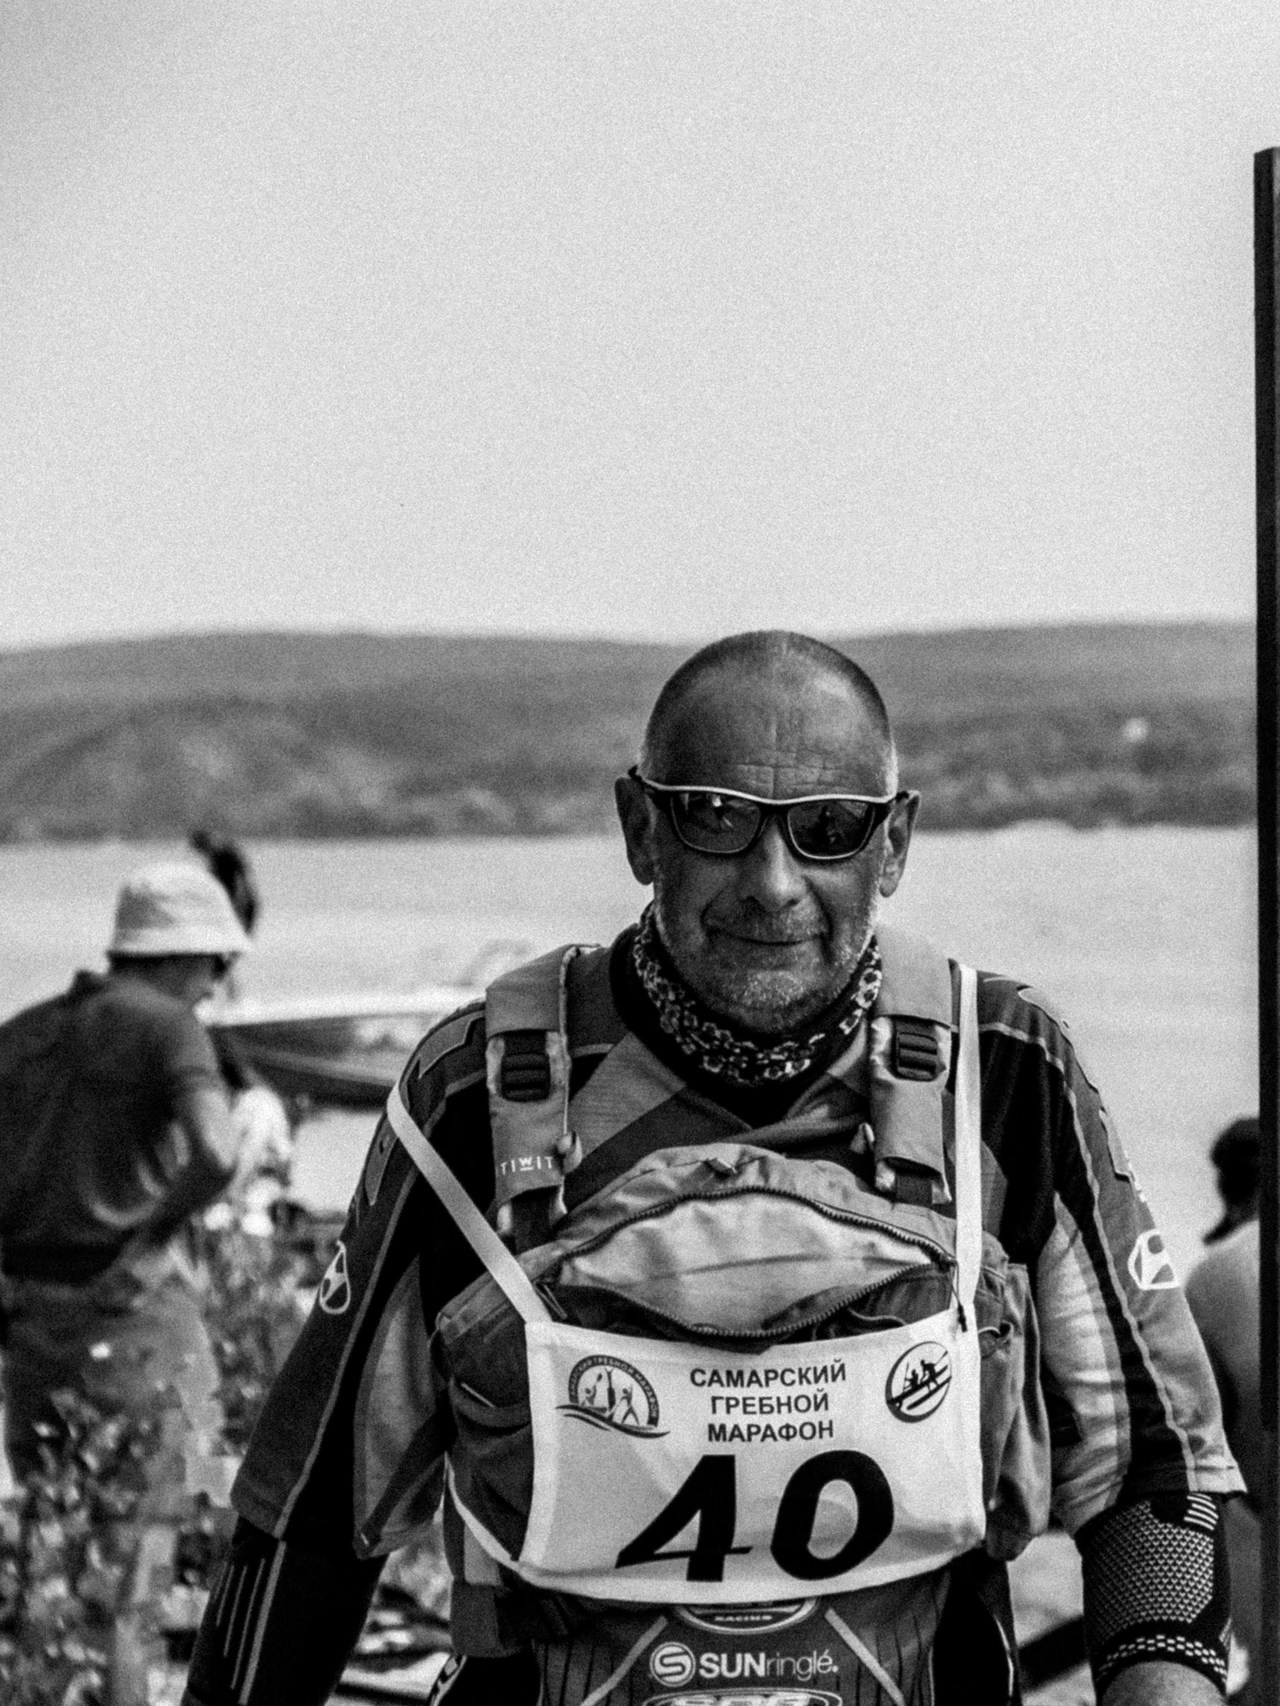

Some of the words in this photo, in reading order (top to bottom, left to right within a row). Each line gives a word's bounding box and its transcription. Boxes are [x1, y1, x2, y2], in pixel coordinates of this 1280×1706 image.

[690, 1359, 847, 1388] САМАРСКИЙ
[710, 1388, 829, 1416] ГРЕБНОЙ
[707, 1420, 834, 1443] МАРАФОН
[614, 1450, 895, 1582] 40
